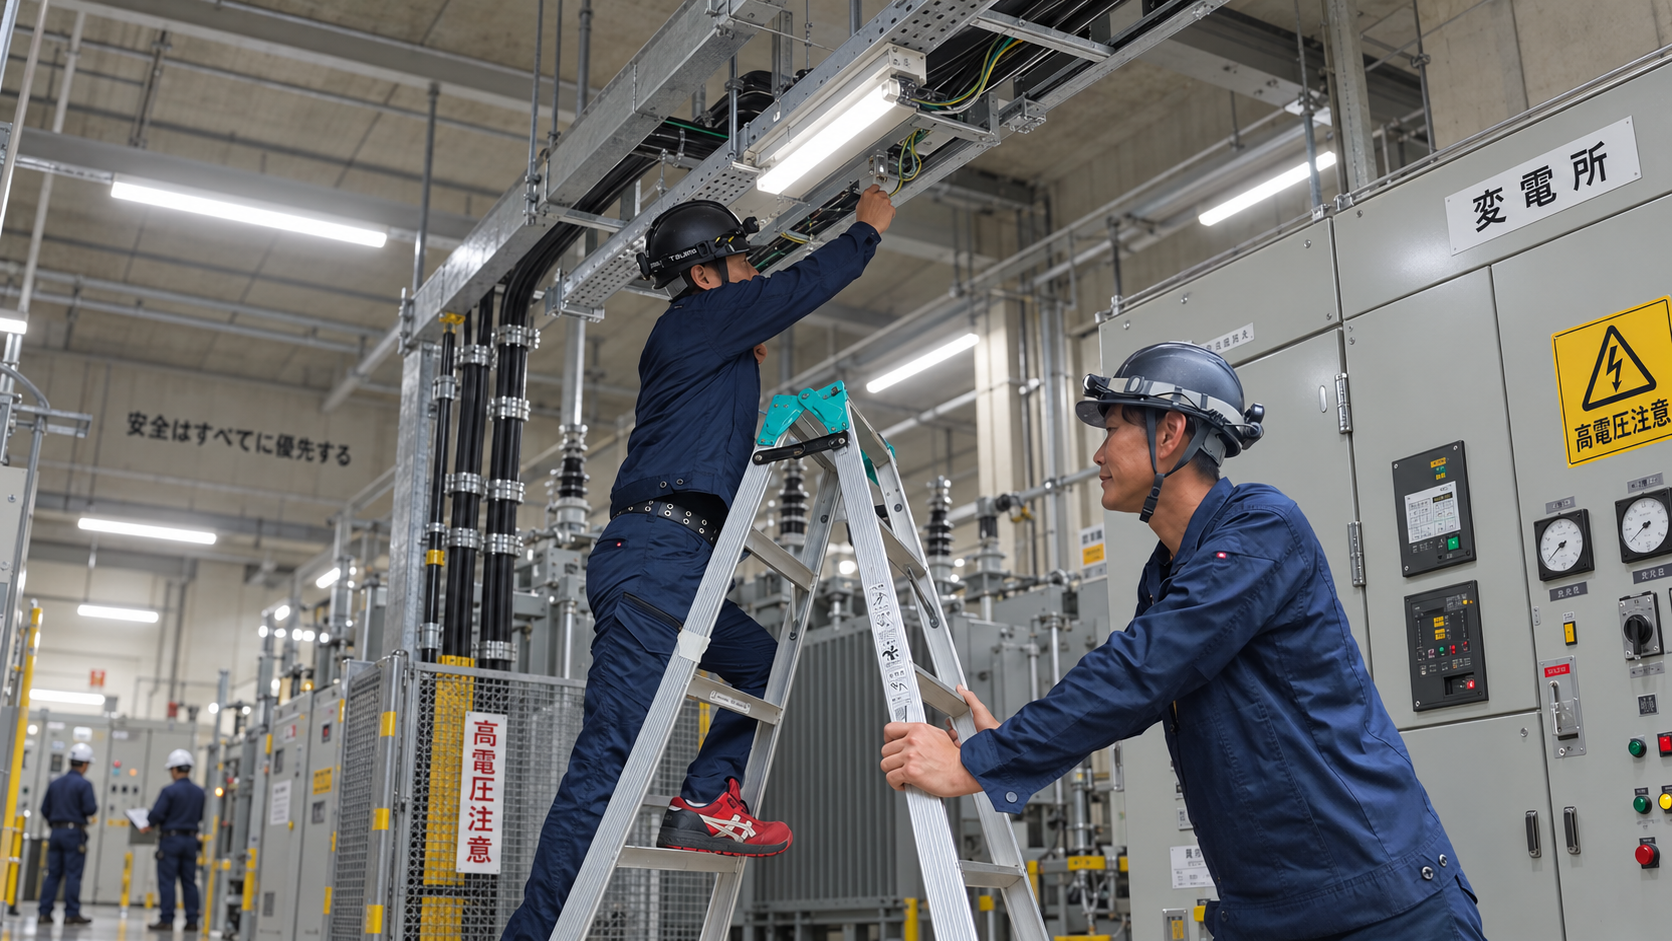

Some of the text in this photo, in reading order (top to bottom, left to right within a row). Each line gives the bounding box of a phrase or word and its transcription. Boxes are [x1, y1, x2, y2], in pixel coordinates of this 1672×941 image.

[1473, 140, 1607, 233] 変電所
[126, 411, 352, 467] 安全はすべてに優先する
[1574, 398, 1671, 453] 高電圧注意
[466, 720, 498, 864] 高電圧注意
